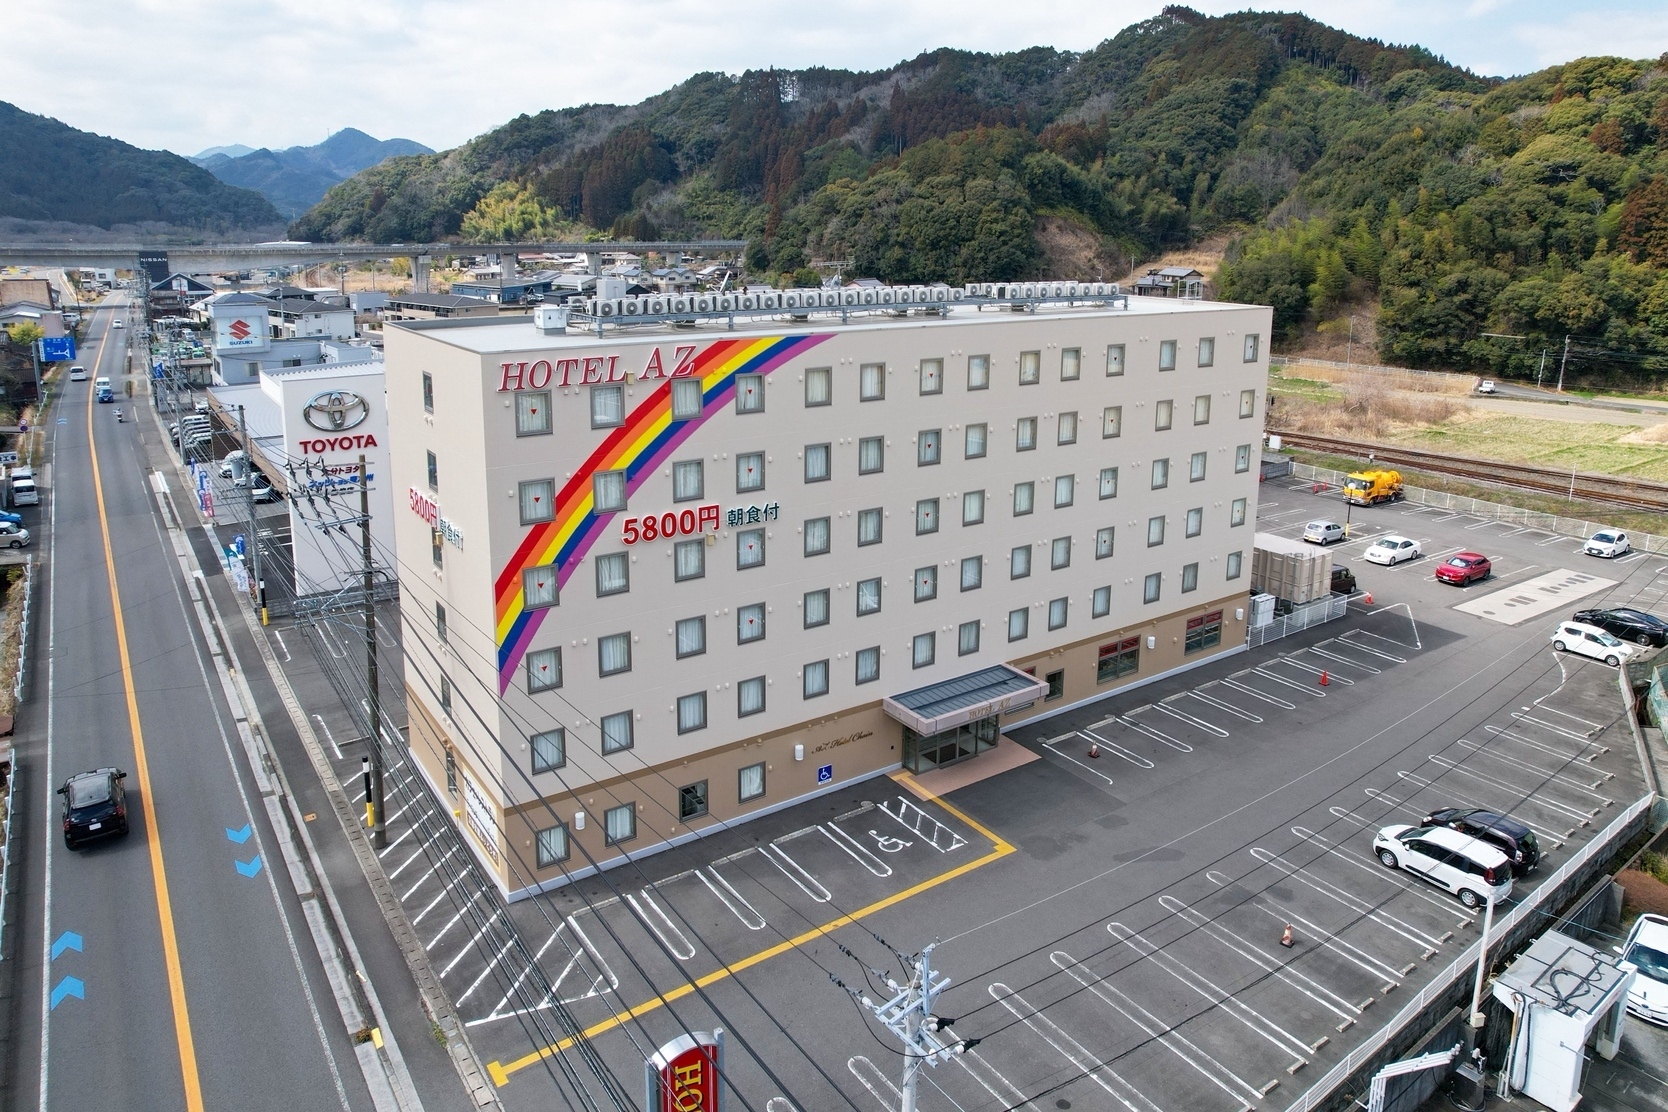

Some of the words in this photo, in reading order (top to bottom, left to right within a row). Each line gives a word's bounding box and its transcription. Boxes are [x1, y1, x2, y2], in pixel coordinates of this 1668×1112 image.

[497, 354, 627, 392] HOTEL
[637, 345, 697, 381] AZ
[299, 434, 378, 454] TOYOTA
[409, 487, 438, 530] 5800円
[622, 504, 720, 545] 5800円
[726, 502, 780, 527] 朝食付
[968, 703, 994, 719] HOTEL
[998, 697, 1012, 710] AZ
[852, 730, 874, 742] Chain
[675, 1060, 703, 1112] HO
